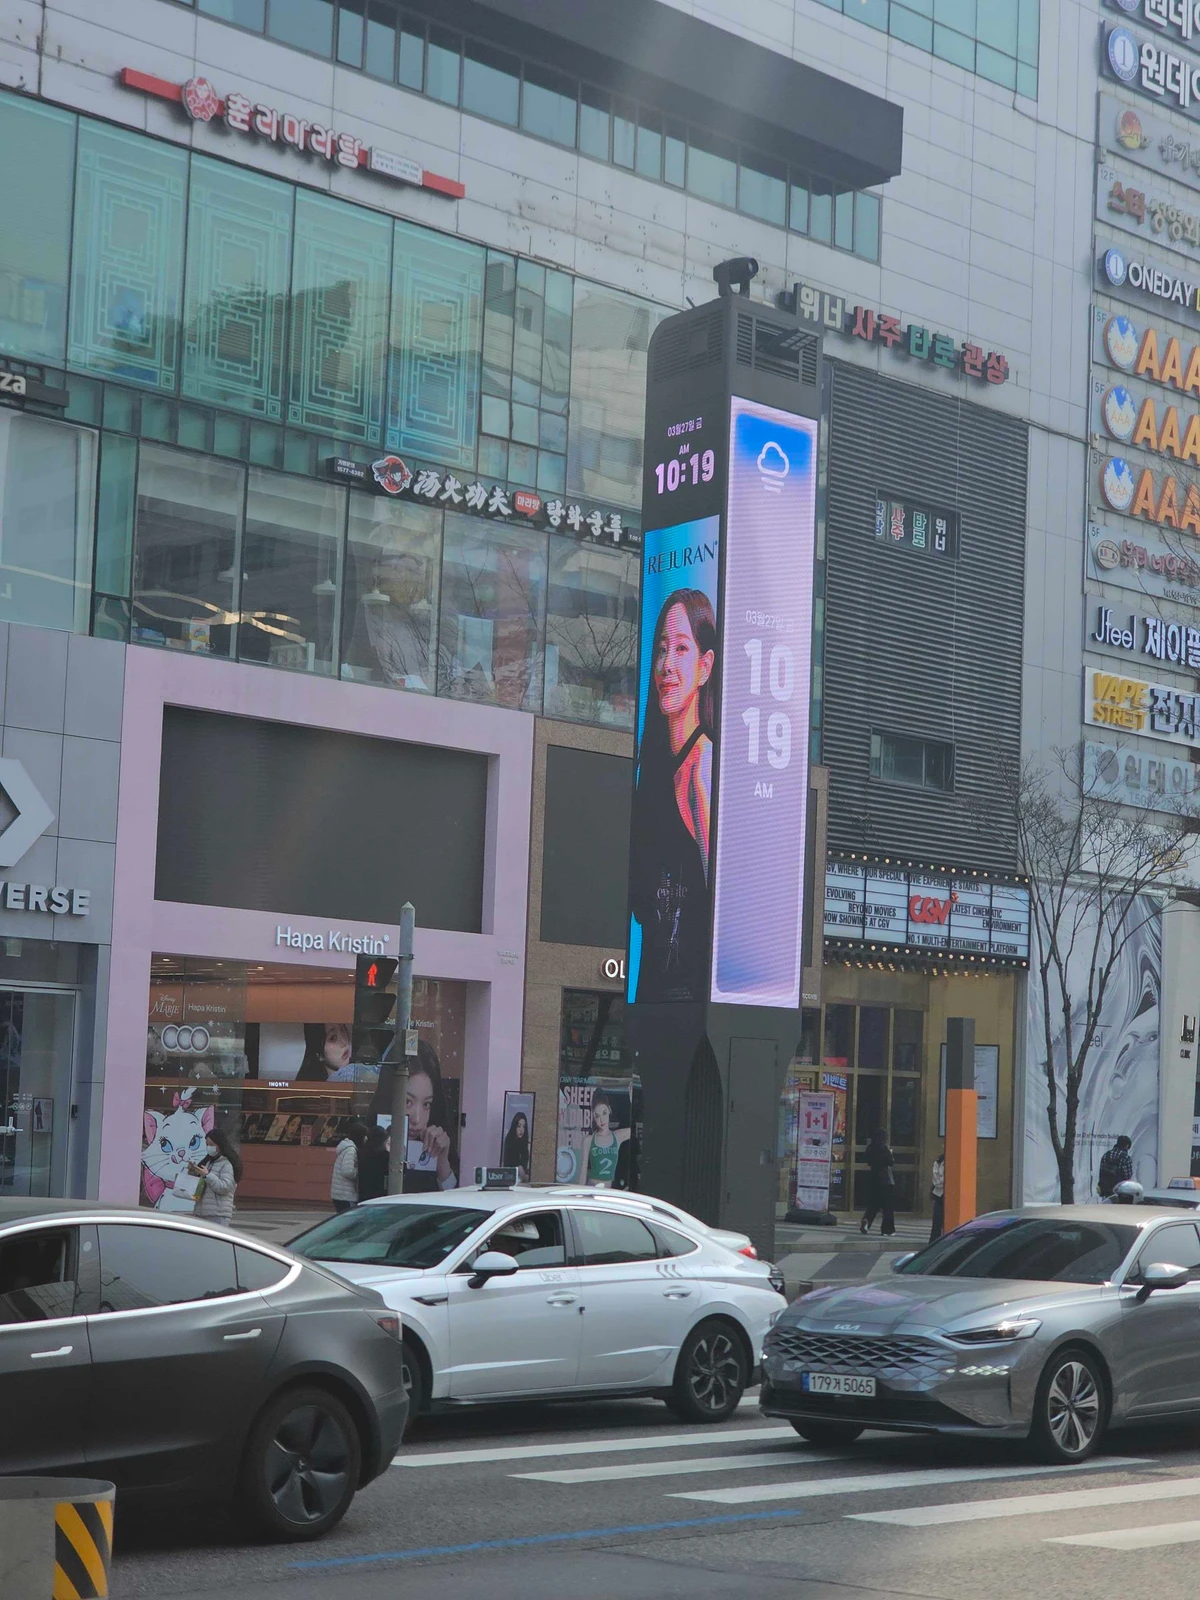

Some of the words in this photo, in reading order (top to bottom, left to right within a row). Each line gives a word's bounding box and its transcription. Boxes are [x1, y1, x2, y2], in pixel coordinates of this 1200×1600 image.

[226, 92, 363, 170] 춘리마라탕
[1129, 262, 1193, 307] ONEDAY
[1096, 311, 1107, 323] 5F
[801, 285, 843, 330] 위너
[852, 305, 901, 347] 사주
[907, 323, 956, 370] 타로
[962, 342, 1009, 386] 관상
[1094, 382, 1105, 394] 5F
[667, 420, 695, 437] 03월27일
[678, 443, 690, 456] AM
[1093, 453, 1103, 466] 5F
[655, 449, 715, 495] 10:19
[516, 493, 541, 511] 마라탕
[647, 541, 716, 576] REJURAN
[1095, 606, 1137, 650] Jfeel
[743, 637, 795, 702] 10
[1093, 672, 1149, 709] VAPE
[1093, 702, 1147, 730] STREET
[741, 706, 792, 770] 19
[753, 781, 774, 799] AM
[838, 863, 857, 877] WHERE
[858, 865, 878, 879] YOUR
[878, 868, 901, 882] SPECIAL
[923, 875, 957, 890] EXPERIENCE
[958, 879, 980, 893] STARTS
[826, 888, 856, 901] EVOLVING
[848, 902, 873, 915] BEYOND
[874, 905, 897, 918] MOVIES
[909, 895, 951, 925] CGV
[951, 903, 972, 916] LATEST
[972, 906, 1003, 919] CINEMATIC
[839, 914, 868, 927] SHOWING
[869, 917, 877, 928] AT
[877, 918, 891, 930] CGV
[982, 918, 1022, 933] ENVIRONMENT
[275, 925, 324, 953] Hapa
[989, 942, 1018, 955] PLATFORM
[188, 1003, 206, 1013] Hapa
[205, 1003, 226, 1013] Kristin
[805, 1111, 829, 1130] 1+1
[599, 1158, 613, 1175] 2
[488, 1171, 503, 1181] Uber
[538, 1271, 562, 1283] Uber
[843, 1377, 873, 1394] 5065
